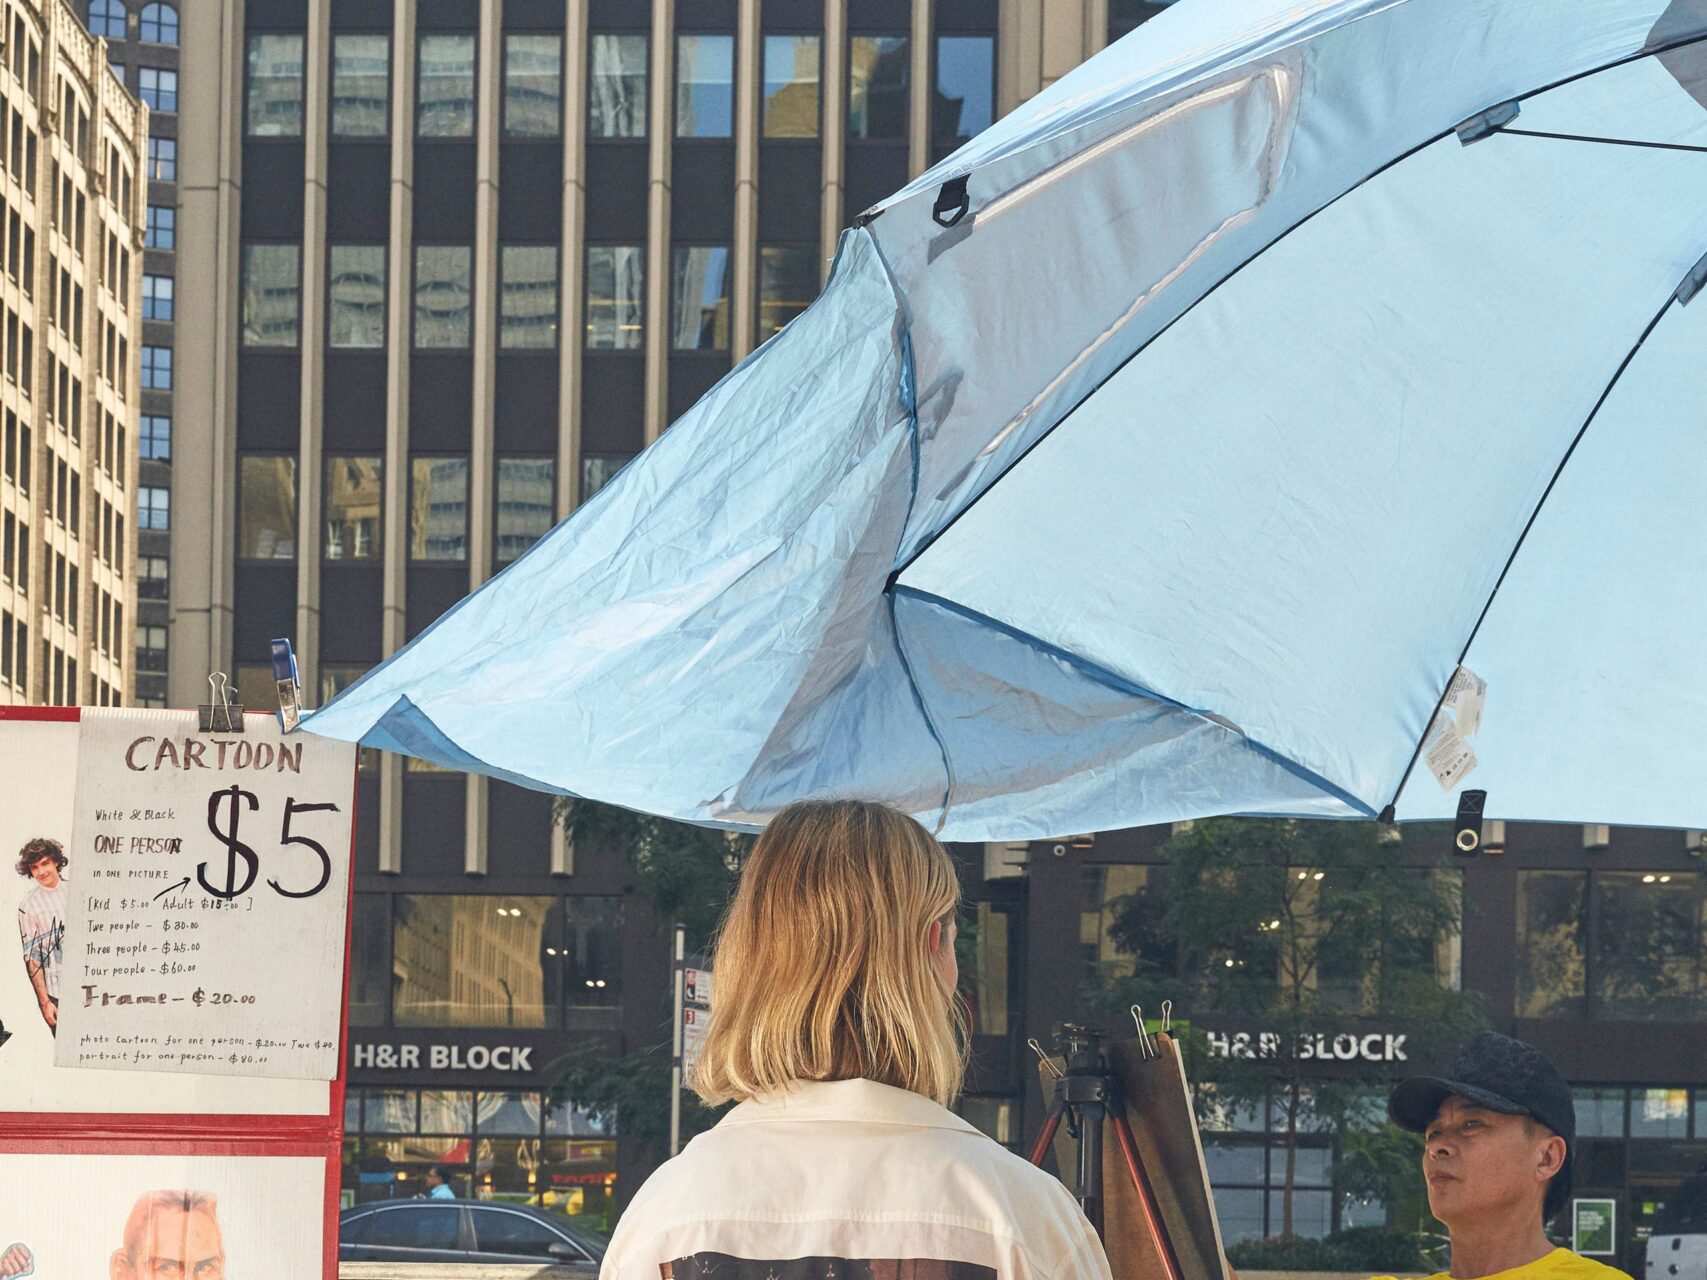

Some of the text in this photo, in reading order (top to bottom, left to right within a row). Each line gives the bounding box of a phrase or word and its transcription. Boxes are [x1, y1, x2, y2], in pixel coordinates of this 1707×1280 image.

[125, 735, 303, 774] CARTOON
[95, 809, 123, 821] White
[144, 808, 175, 821] Black
[94, 834, 184, 855] ONE PERSON
[197, 784, 341, 901] $5
[106, 869, 121, 879] ONE
[128, 869, 169, 879] PICTURE
[162, 895, 194, 911] Adult
[109, 919, 140, 934] people
[86, 941, 111, 955] Three
[116, 941, 148, 957] people
[112, 963, 146, 977] people
[81, 985, 168, 1008] Frame
[80, 1034, 109, 1047] photo
[164, 1035, 182, 1046] for
[1292, 1032, 1408, 1061] BLOCK
[80, 1051, 128, 1064] portrait
[133, 1050, 152, 1064] for
[180, 1053, 215, 1065] person
[354, 1044, 533, 1071] H&R BLOCK
